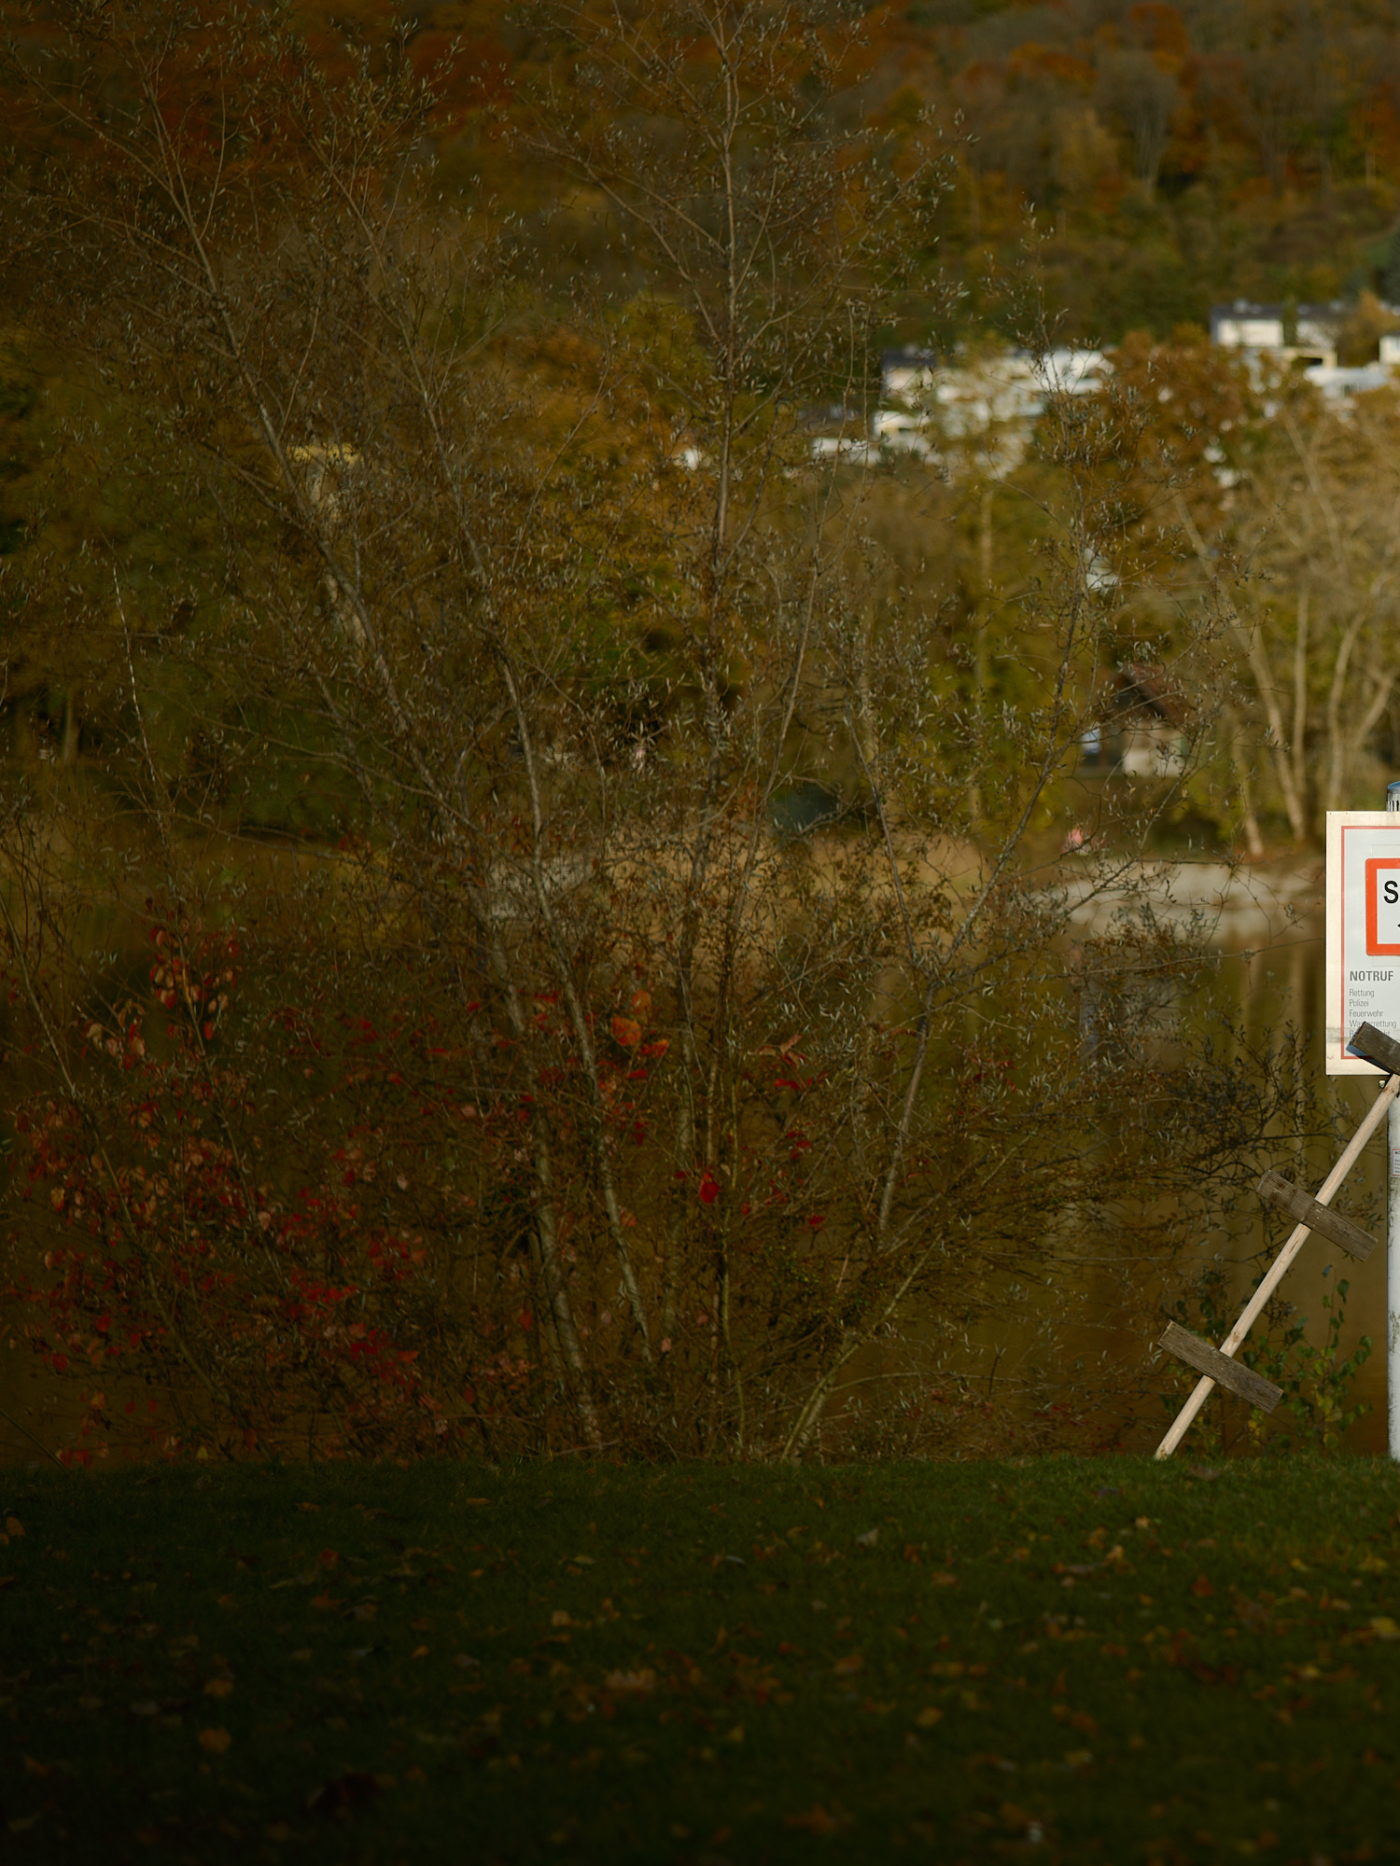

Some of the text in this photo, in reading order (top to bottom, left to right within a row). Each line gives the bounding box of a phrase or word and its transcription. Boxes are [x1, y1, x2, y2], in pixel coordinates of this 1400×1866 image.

[1350, 970, 1394, 982] NOTRUF
[1349, 989, 1375, 998] Rettung
[1349, 999, 1370, 1007] Polizei
[1349, 1009, 1384, 1018] Feuerwehr
